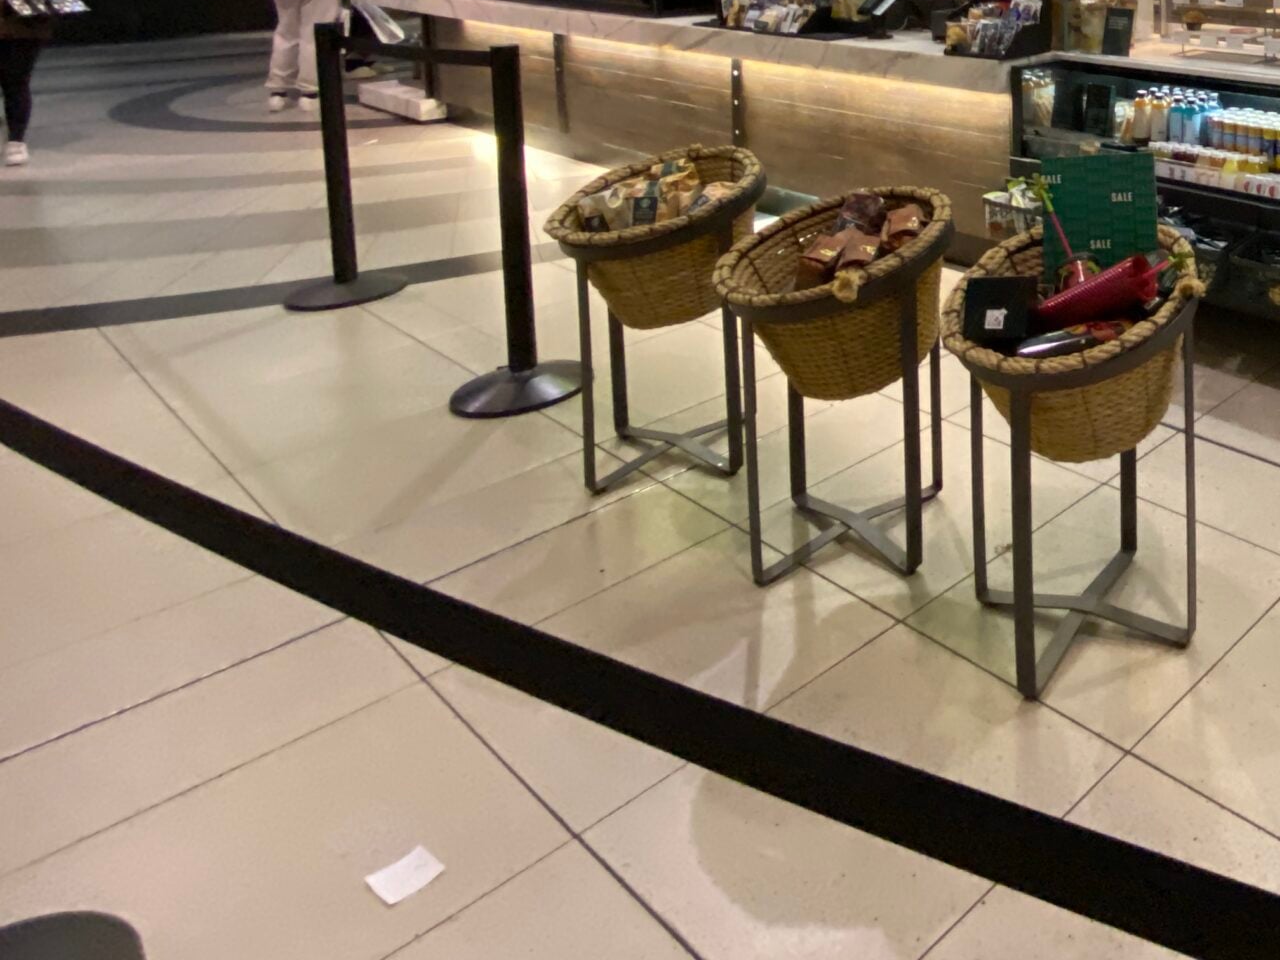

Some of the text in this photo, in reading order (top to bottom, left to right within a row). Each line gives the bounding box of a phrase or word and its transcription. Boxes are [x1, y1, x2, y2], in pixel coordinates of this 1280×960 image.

[1041, 174, 1062, 184] SALE
[1111, 192, 1133, 202] SALE
[1090, 240, 1111, 249] SALE
